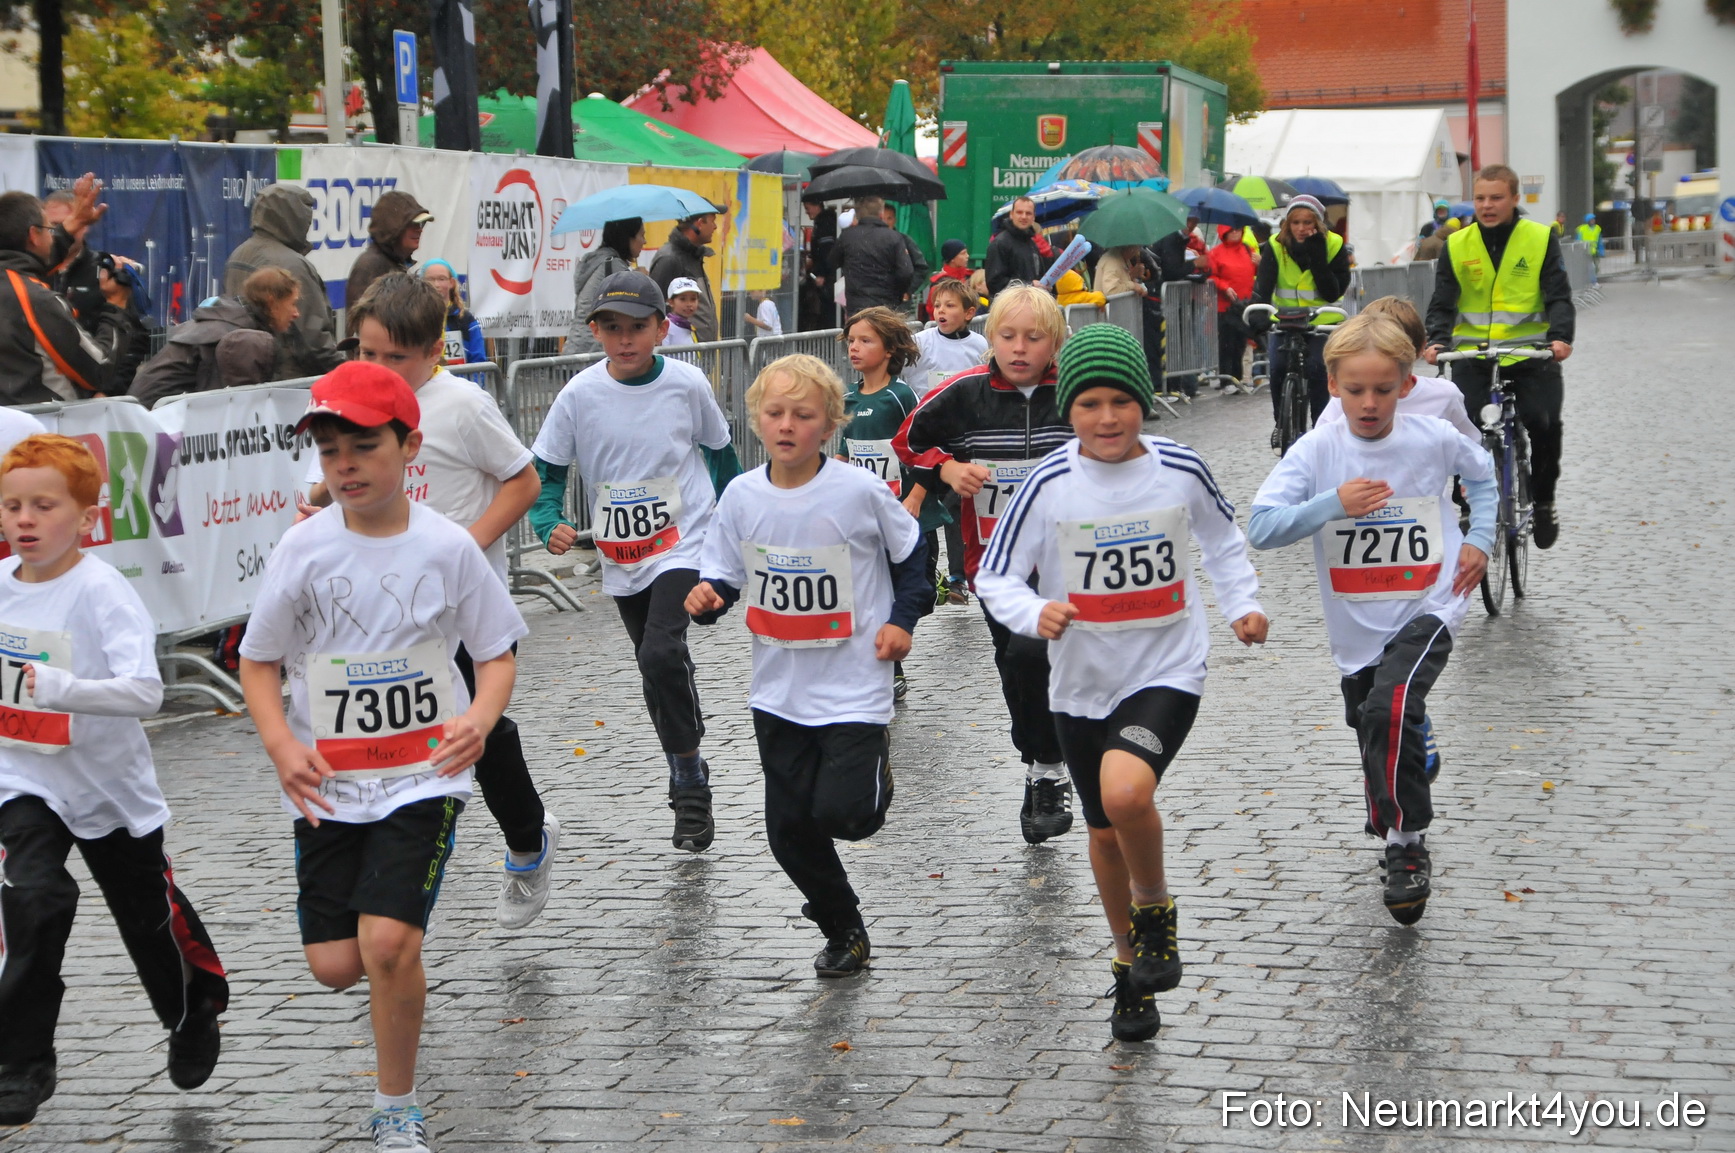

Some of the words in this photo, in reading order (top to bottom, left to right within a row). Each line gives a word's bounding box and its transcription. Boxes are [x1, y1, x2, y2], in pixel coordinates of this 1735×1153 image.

[399, 41, 411, 94] P
[477, 200, 534, 230] GERHART
[475, 232, 503, 247] Autohaus
[546, 258, 571, 271] SEAT
[610, 487, 646, 499] BOCK
[203, 489, 240, 527] Jetzt
[602, 501, 670, 539] 7085
[1095, 521, 1150, 539] BOCK
[615, 543, 654, 560] Niklas
[1336, 525, 1430, 565] 7276
[767, 554, 812, 566] BOCK
[1075, 540, 1176, 590] 7353
[755, 570, 838, 612] 7300
[346, 658, 409, 677] BOCK
[325, 677, 438, 734] 7305
[367, 746, 409, 761] Marc
